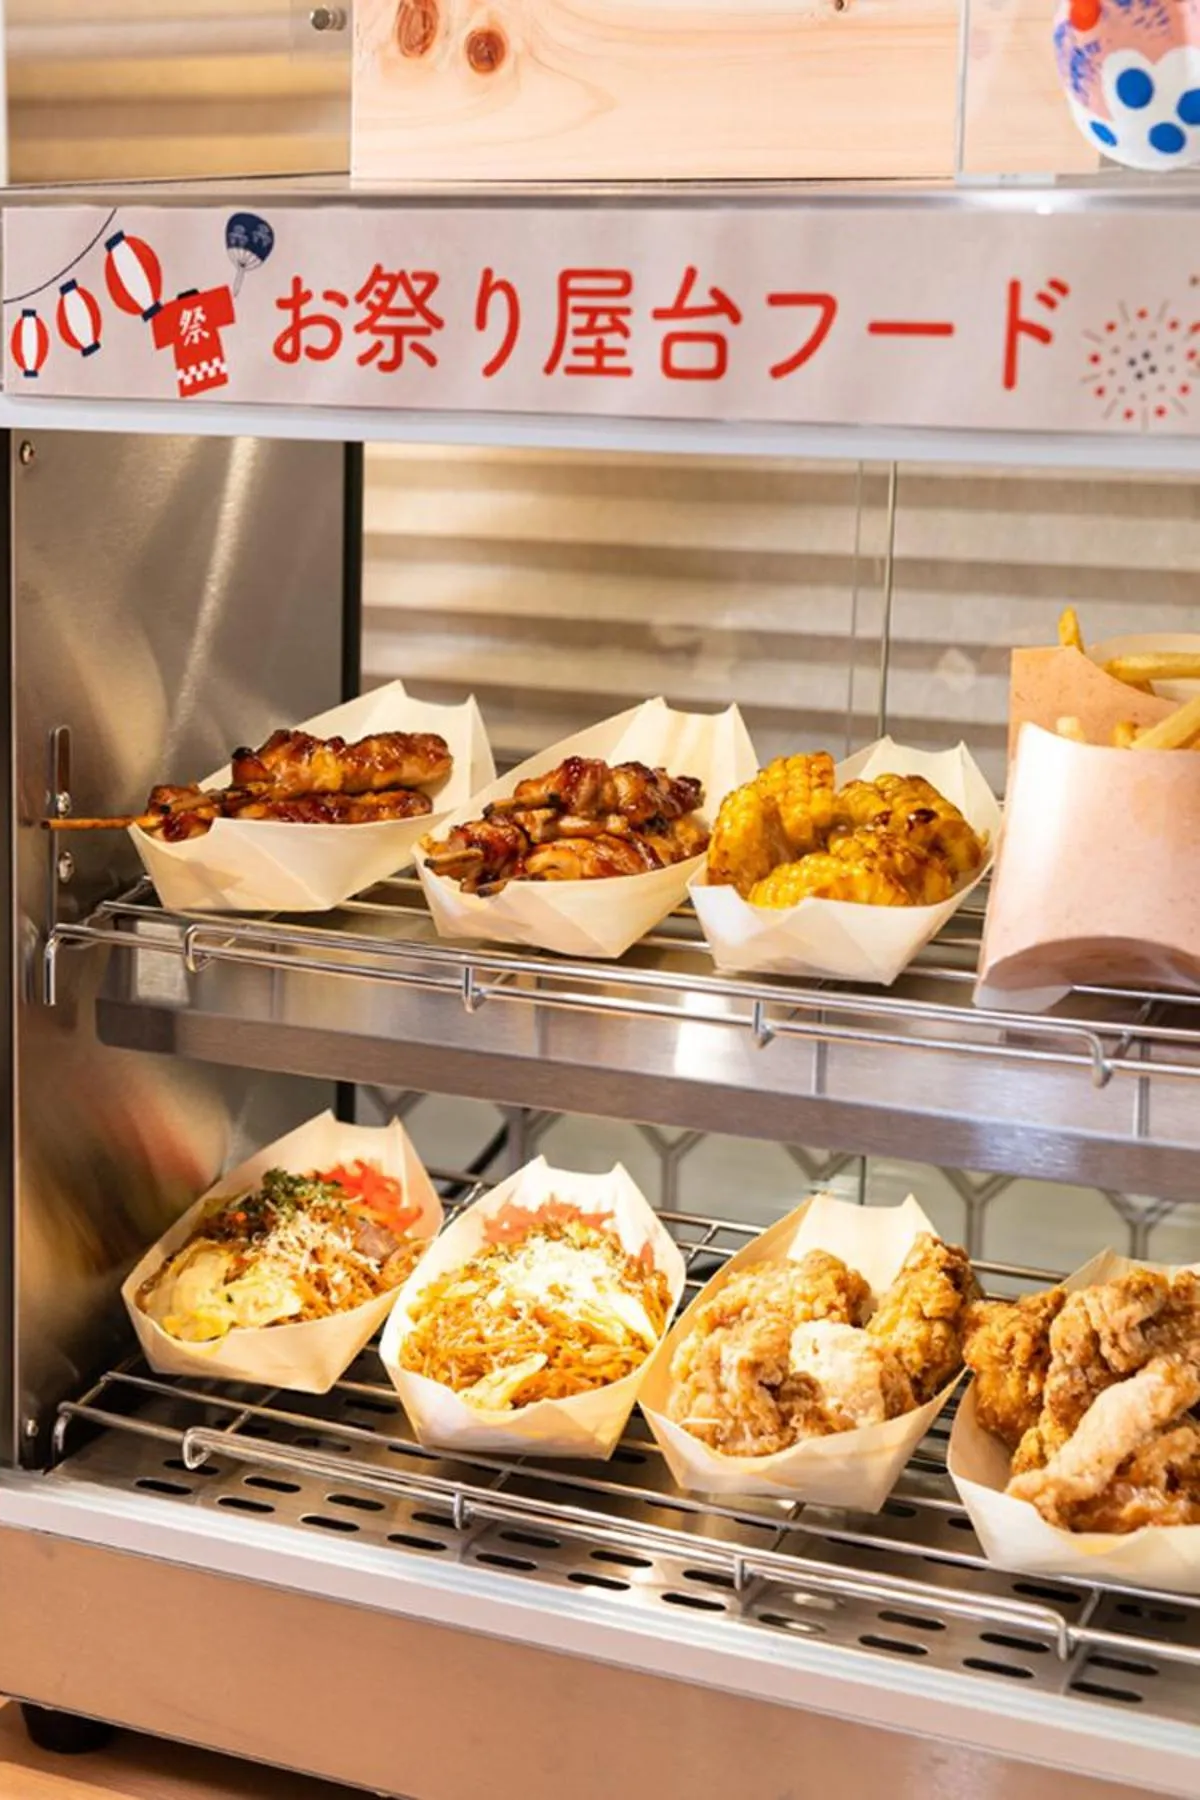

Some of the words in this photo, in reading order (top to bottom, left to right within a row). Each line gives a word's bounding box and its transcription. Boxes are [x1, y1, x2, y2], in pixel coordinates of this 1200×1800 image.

[179, 306, 210, 346] 祭
[272, 264, 1070, 391] お祭り屋台フード
